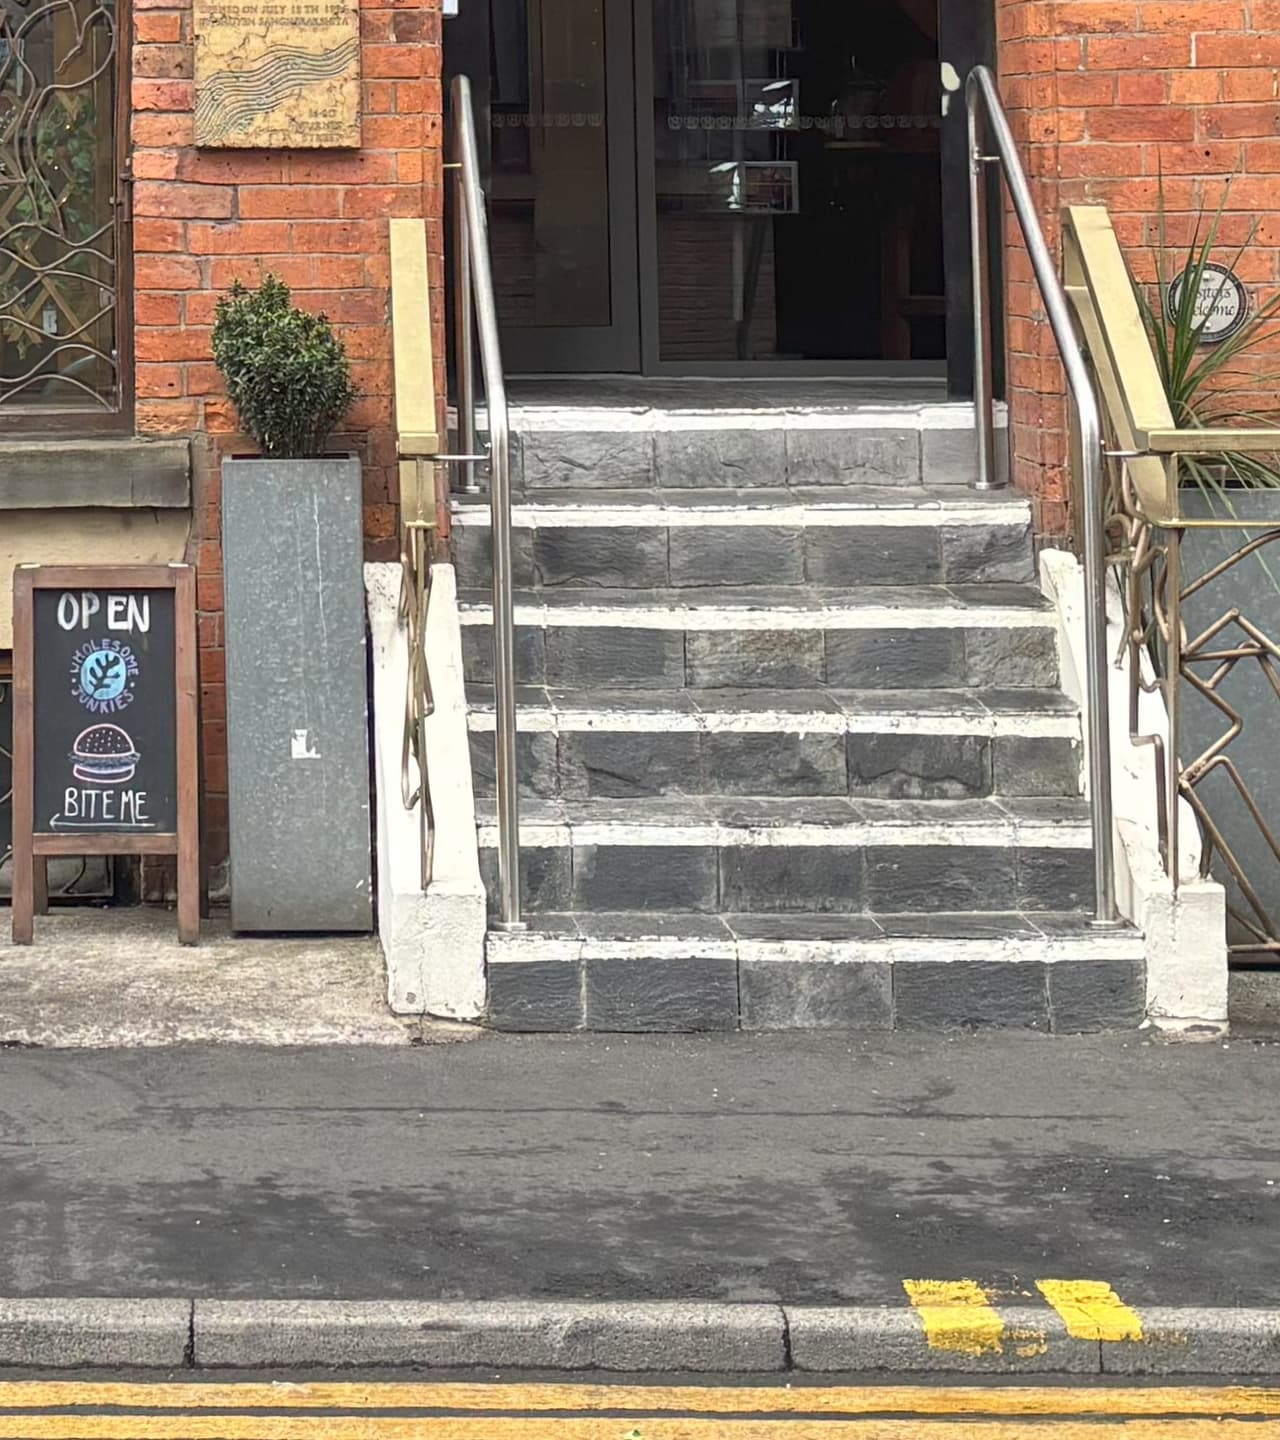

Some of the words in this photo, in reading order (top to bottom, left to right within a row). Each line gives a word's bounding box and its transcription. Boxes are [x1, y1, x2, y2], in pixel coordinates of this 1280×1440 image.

[57, 592, 151, 633] OPEN
[69, 638, 139, 677] WHOLESOME
[71, 684, 134, 713] JUNKIES
[64, 787, 115, 819] BITE
[120, 790, 150, 823] ME
